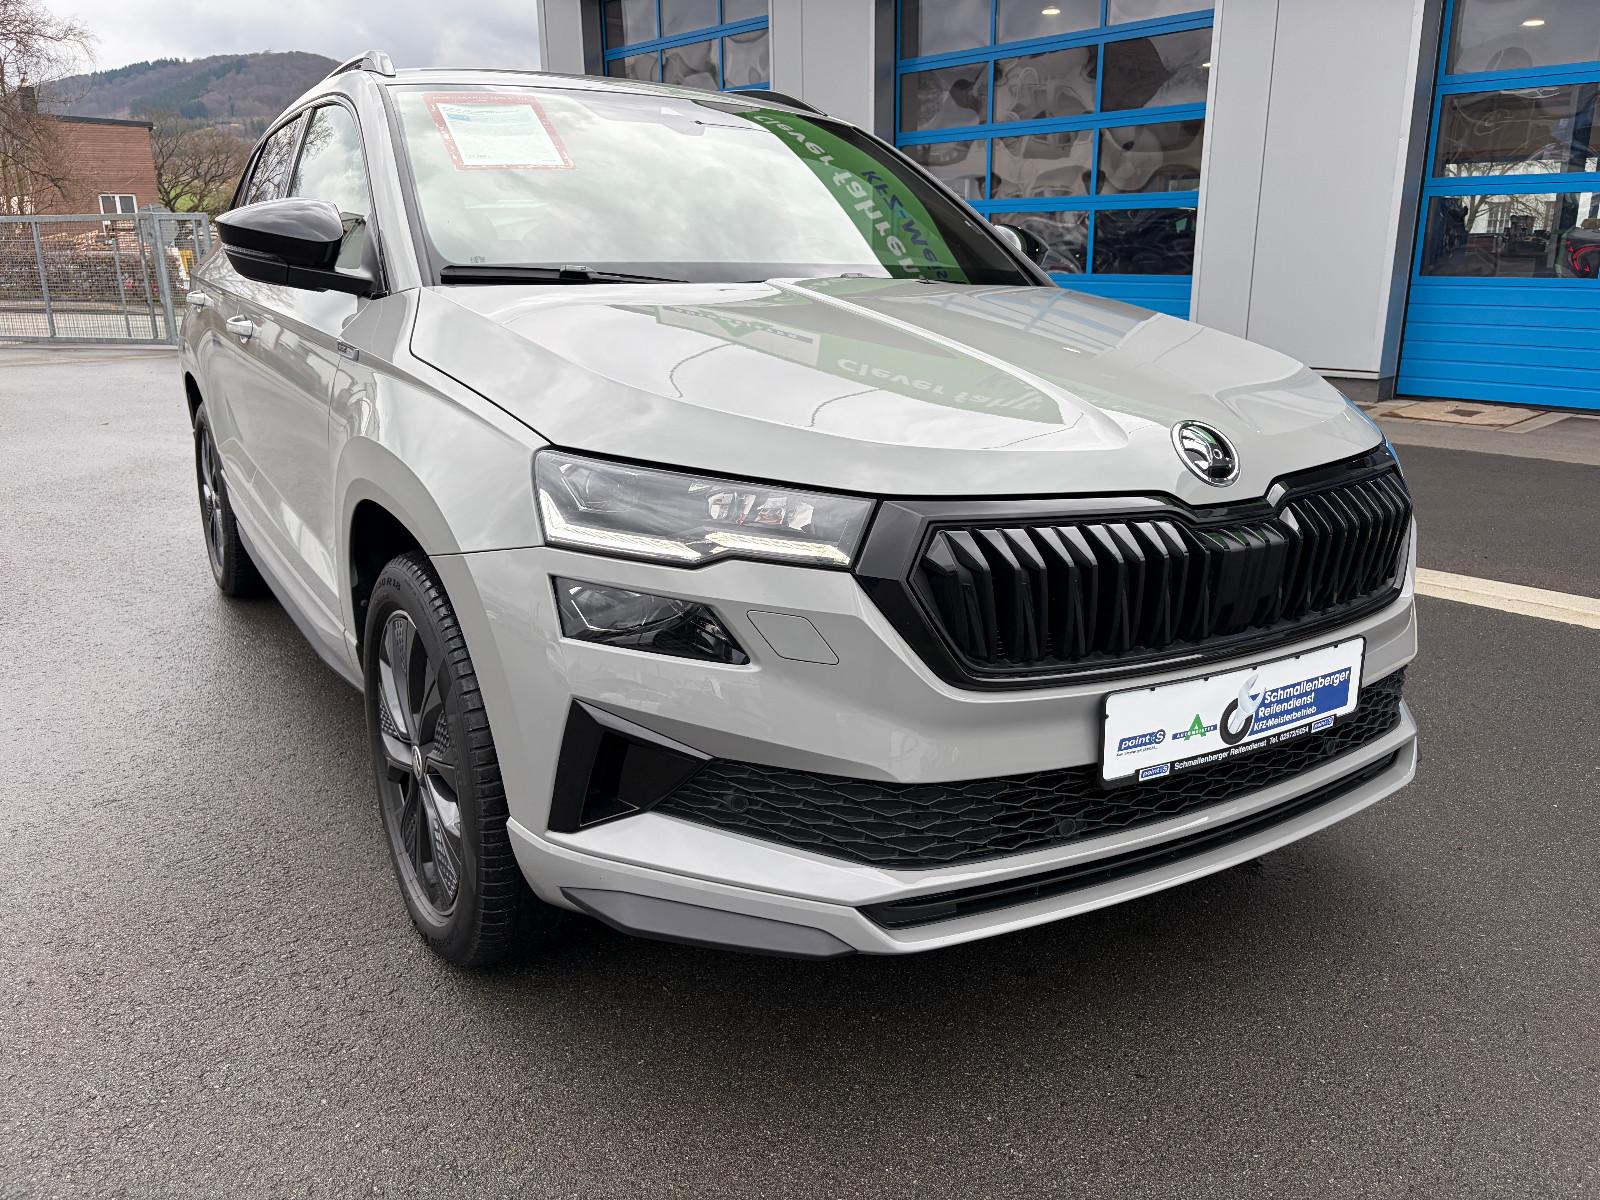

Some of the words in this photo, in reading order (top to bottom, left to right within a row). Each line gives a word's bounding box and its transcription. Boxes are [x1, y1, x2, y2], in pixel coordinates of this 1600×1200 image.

[1264, 670, 1350, 703] Schmallenberger
[1254, 706, 1317, 731] KFZ-Meisterbetrieb
[1258, 692, 1315, 718] Reifendienst
[1174, 751, 1230, 770] Schmallenberger
[1230, 740, 1267, 756] Reifendienst
